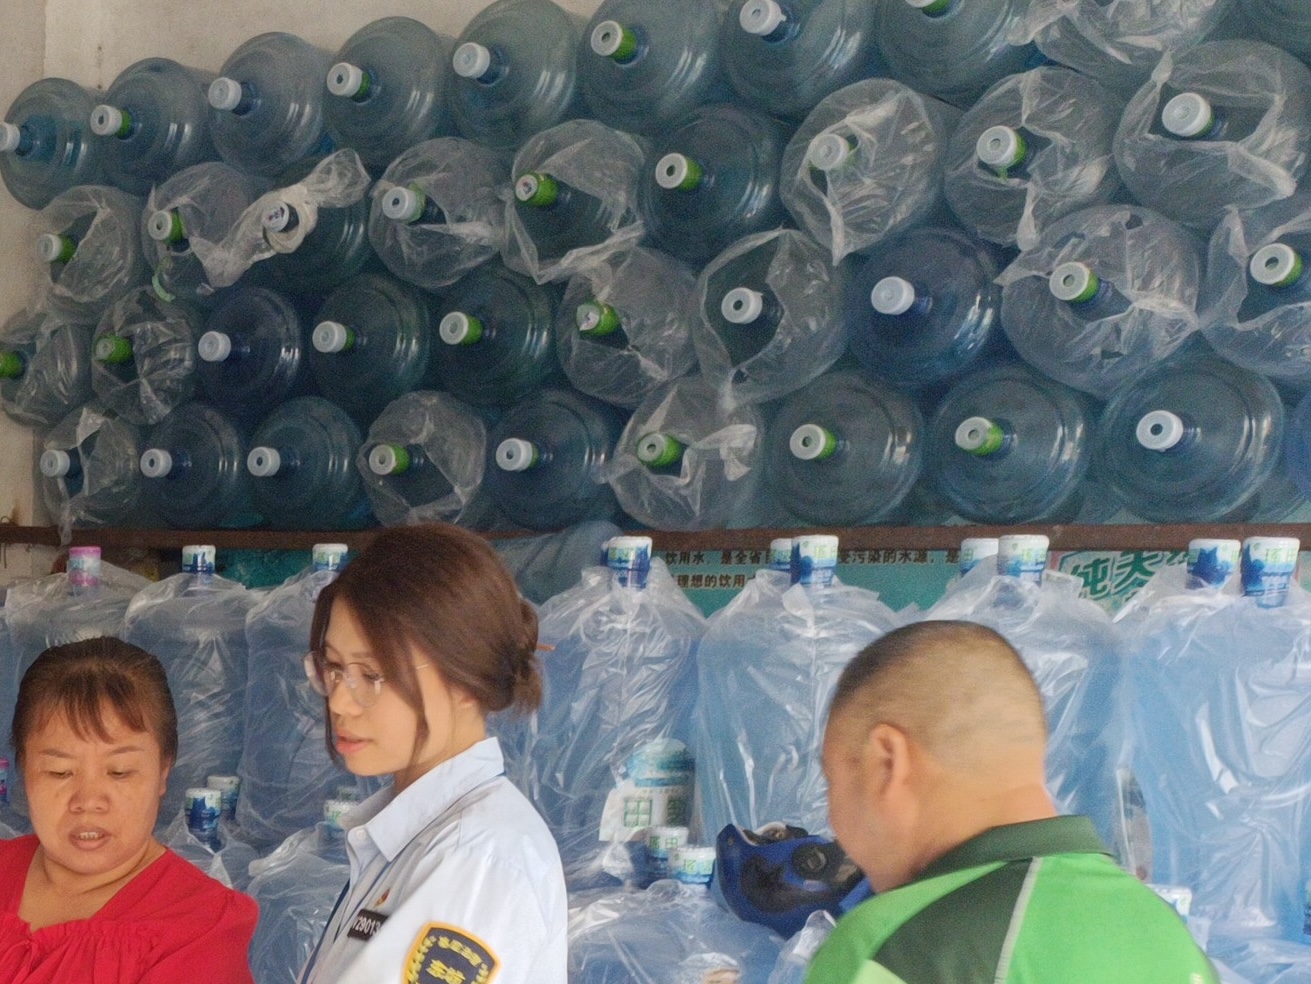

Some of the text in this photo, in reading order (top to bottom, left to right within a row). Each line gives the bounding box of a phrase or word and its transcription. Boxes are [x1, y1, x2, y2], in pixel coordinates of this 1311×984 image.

[676, 573, 756, 589] 理想的饮用
